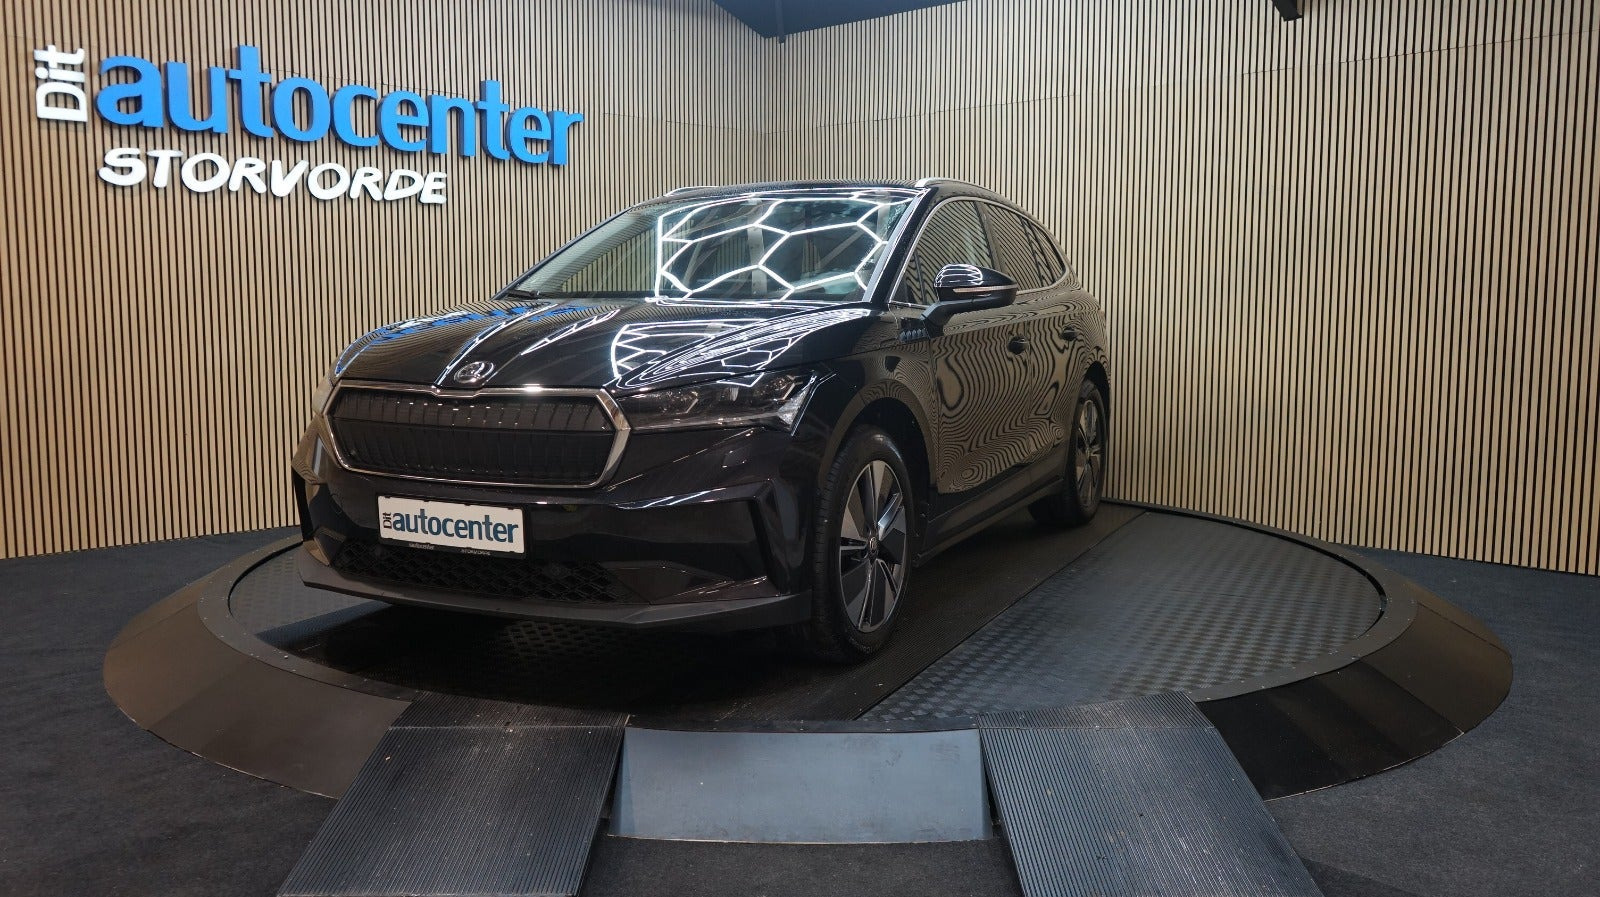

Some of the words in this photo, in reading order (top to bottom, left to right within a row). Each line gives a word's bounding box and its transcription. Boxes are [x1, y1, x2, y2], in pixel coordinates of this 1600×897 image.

[35, 45, 88, 122] Dit
[97, 44, 584, 165] autocenter
[98, 147, 448, 205] STORVORDE
[383, 512, 392, 529] Dit
[392, 508, 519, 543] autocenter
